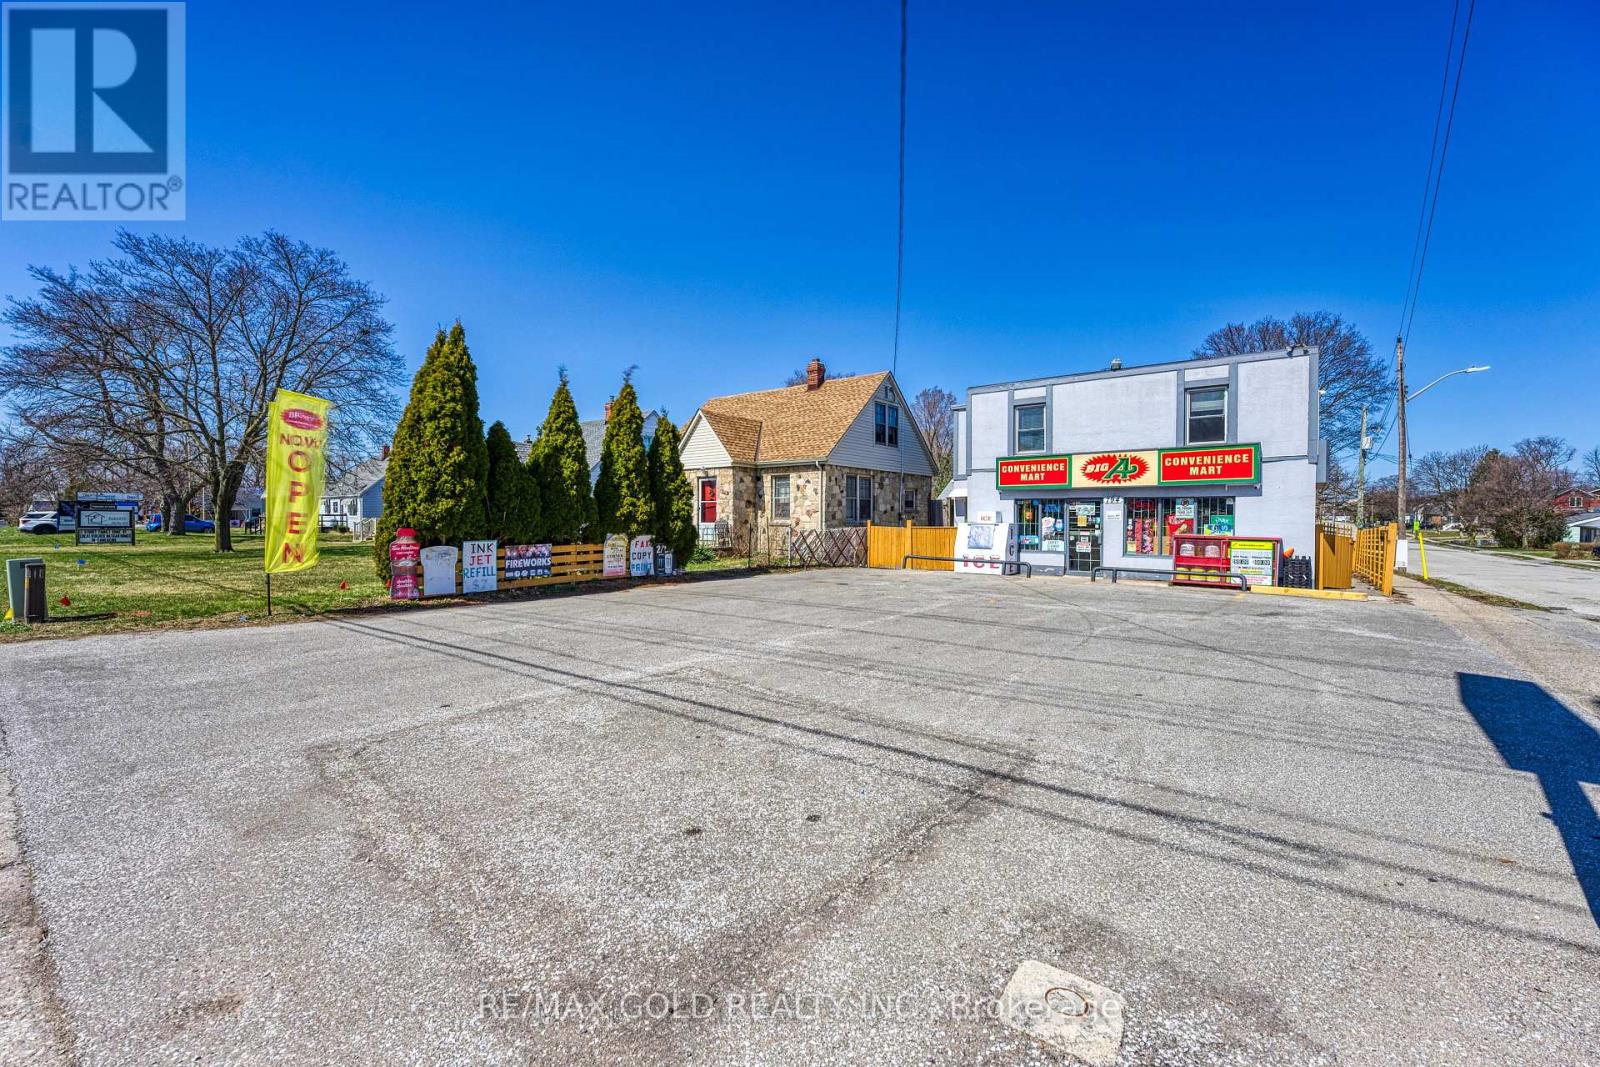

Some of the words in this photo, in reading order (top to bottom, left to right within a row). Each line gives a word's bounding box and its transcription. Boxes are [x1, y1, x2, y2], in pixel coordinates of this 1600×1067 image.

[1164, 453, 1249, 467] CONVENIENCE
[1001, 462, 1065, 474] CONVENIENCE
[1085, 463, 1110, 474] BIG
[1189, 465, 1222, 476] MART
[1020, 472, 1045, 481] MART
[282, 451, 311, 563] OPEN
[470, 543, 494, 554] INK
[469, 554, 492, 566] JET
[631, 551, 652, 561] COPY
[505, 557, 551, 569] FIREWORKS
[463, 566, 496, 579] REFILL
